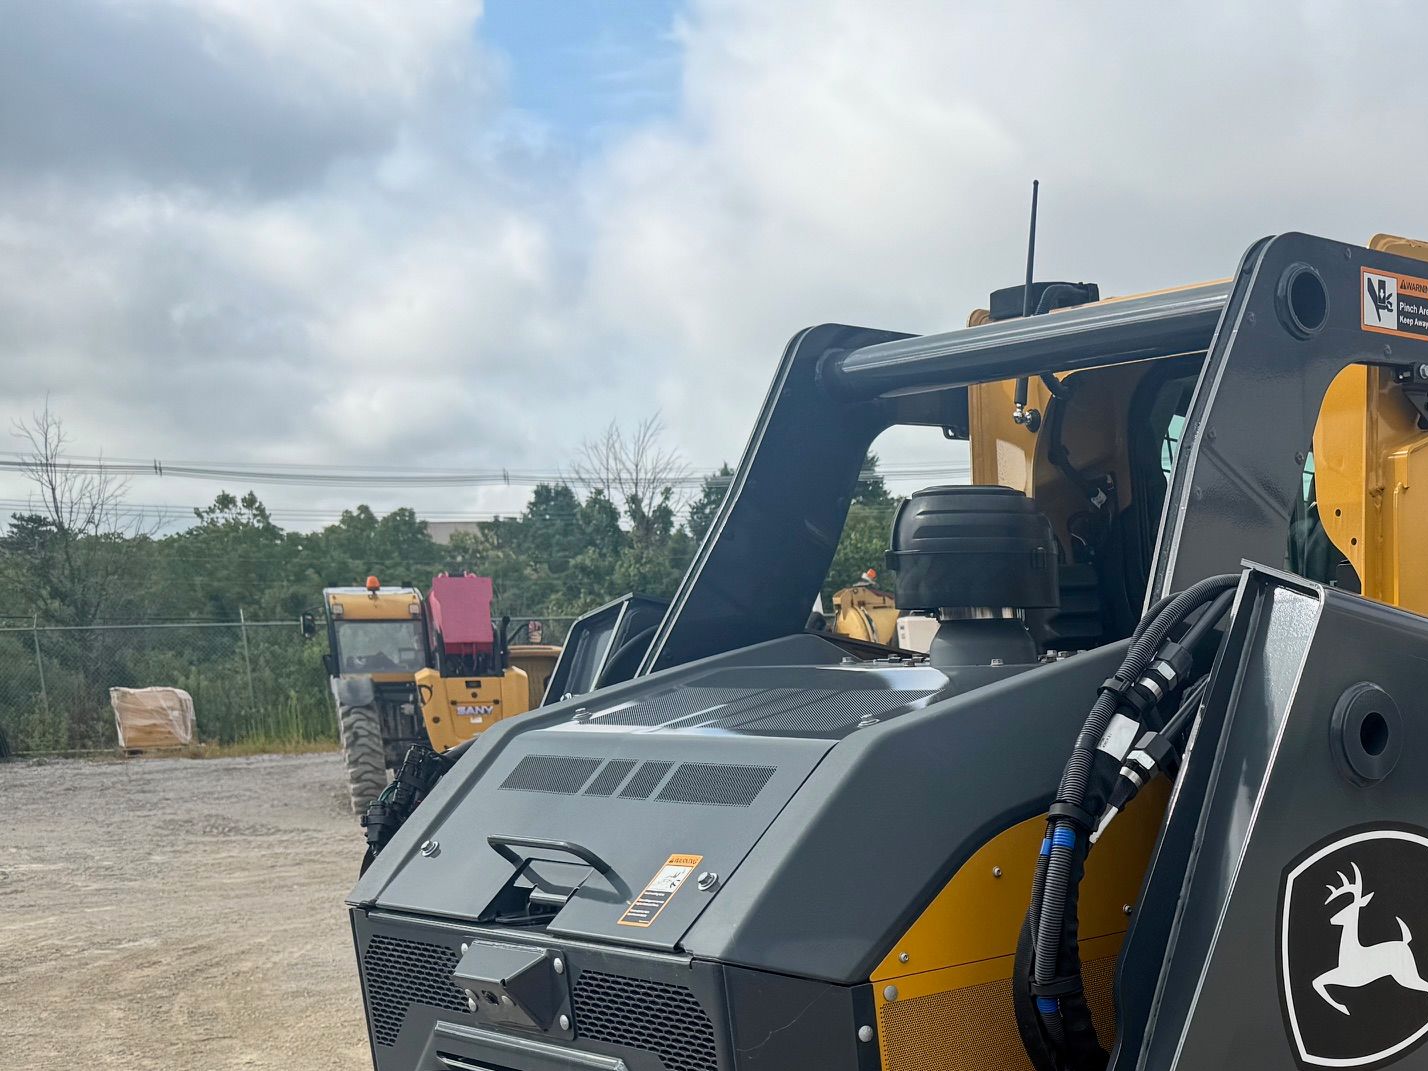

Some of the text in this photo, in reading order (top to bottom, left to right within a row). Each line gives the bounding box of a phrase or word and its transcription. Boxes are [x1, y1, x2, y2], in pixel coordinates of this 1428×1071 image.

[1399, 301, 1418, 314] Pinch
[1399, 315, 1414, 327] Keep
[456, 705, 494, 716] SANY
